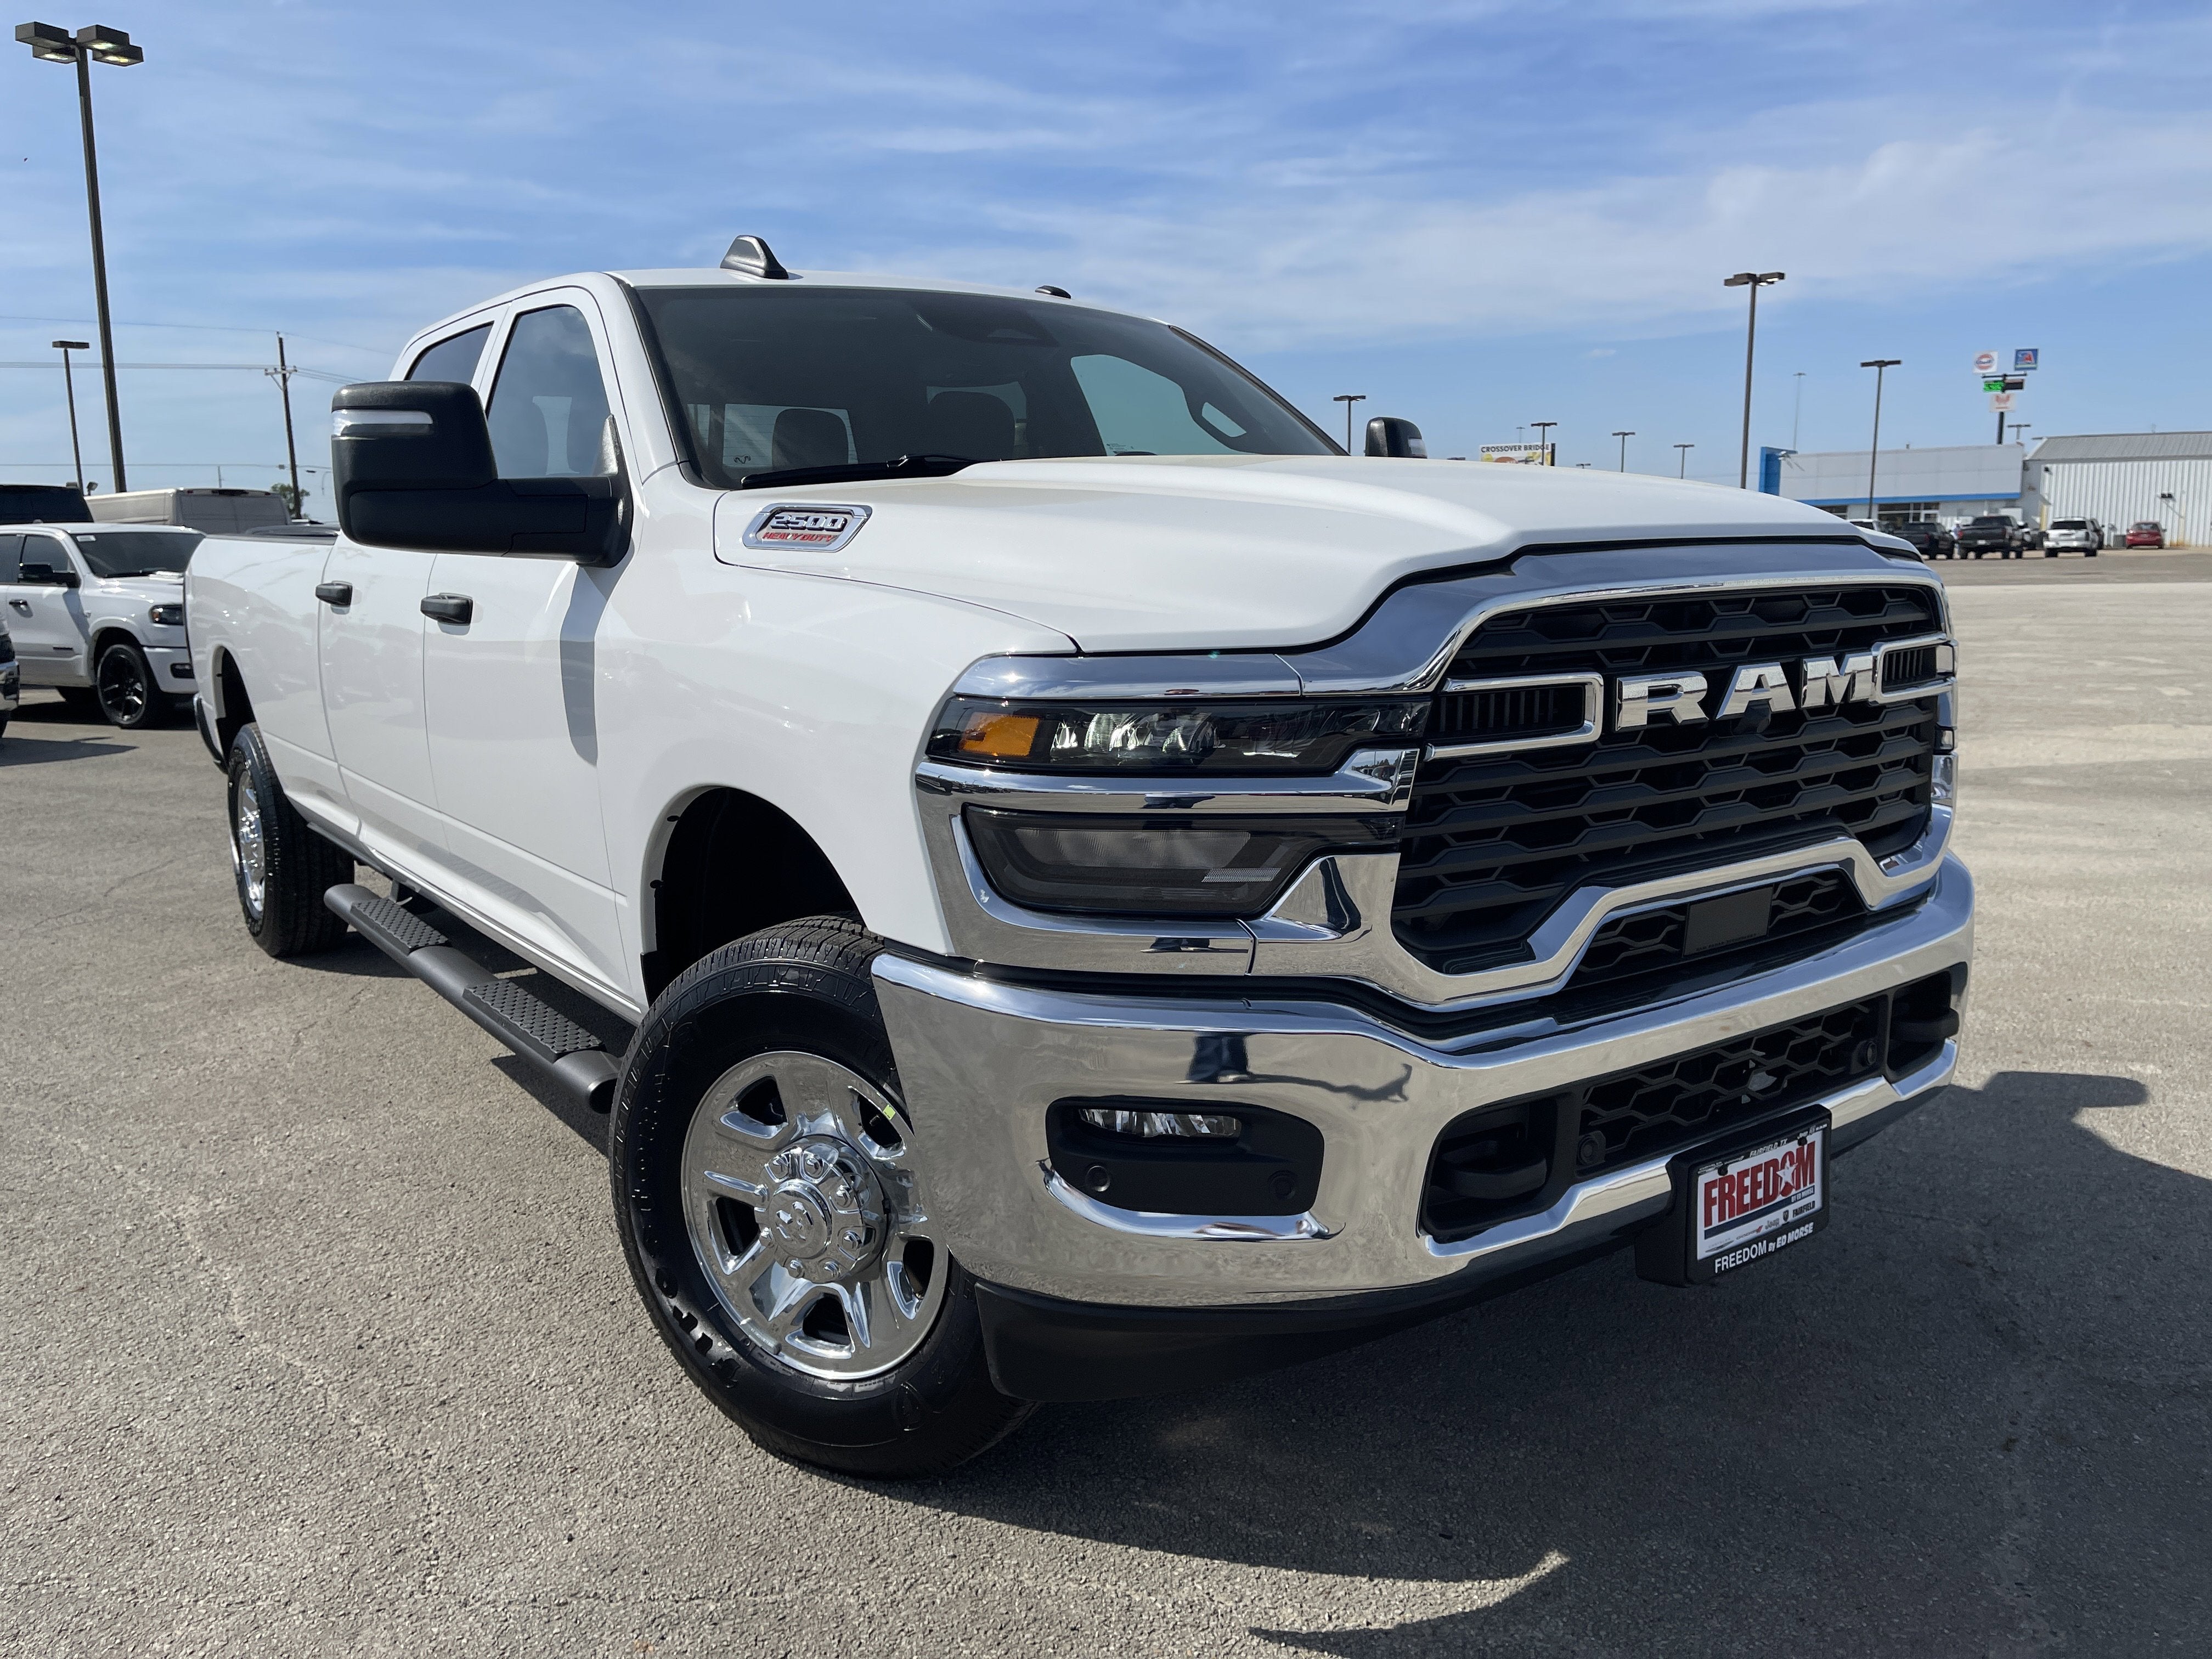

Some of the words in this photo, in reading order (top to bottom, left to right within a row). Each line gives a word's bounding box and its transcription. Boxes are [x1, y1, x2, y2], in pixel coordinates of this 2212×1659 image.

[770, 514, 847, 531] 2500
[802, 533, 837, 542] DUTY
[1616, 652, 1874, 731] RAM
[1780, 1138, 1787, 1147] TX
[1704, 1141, 1816, 1228] FREEDOM
[1715, 1239, 1767, 1273] FREEDOM
[1776, 1234, 1787, 1249] ED
[1787, 1222, 1814, 1244] MORSE
